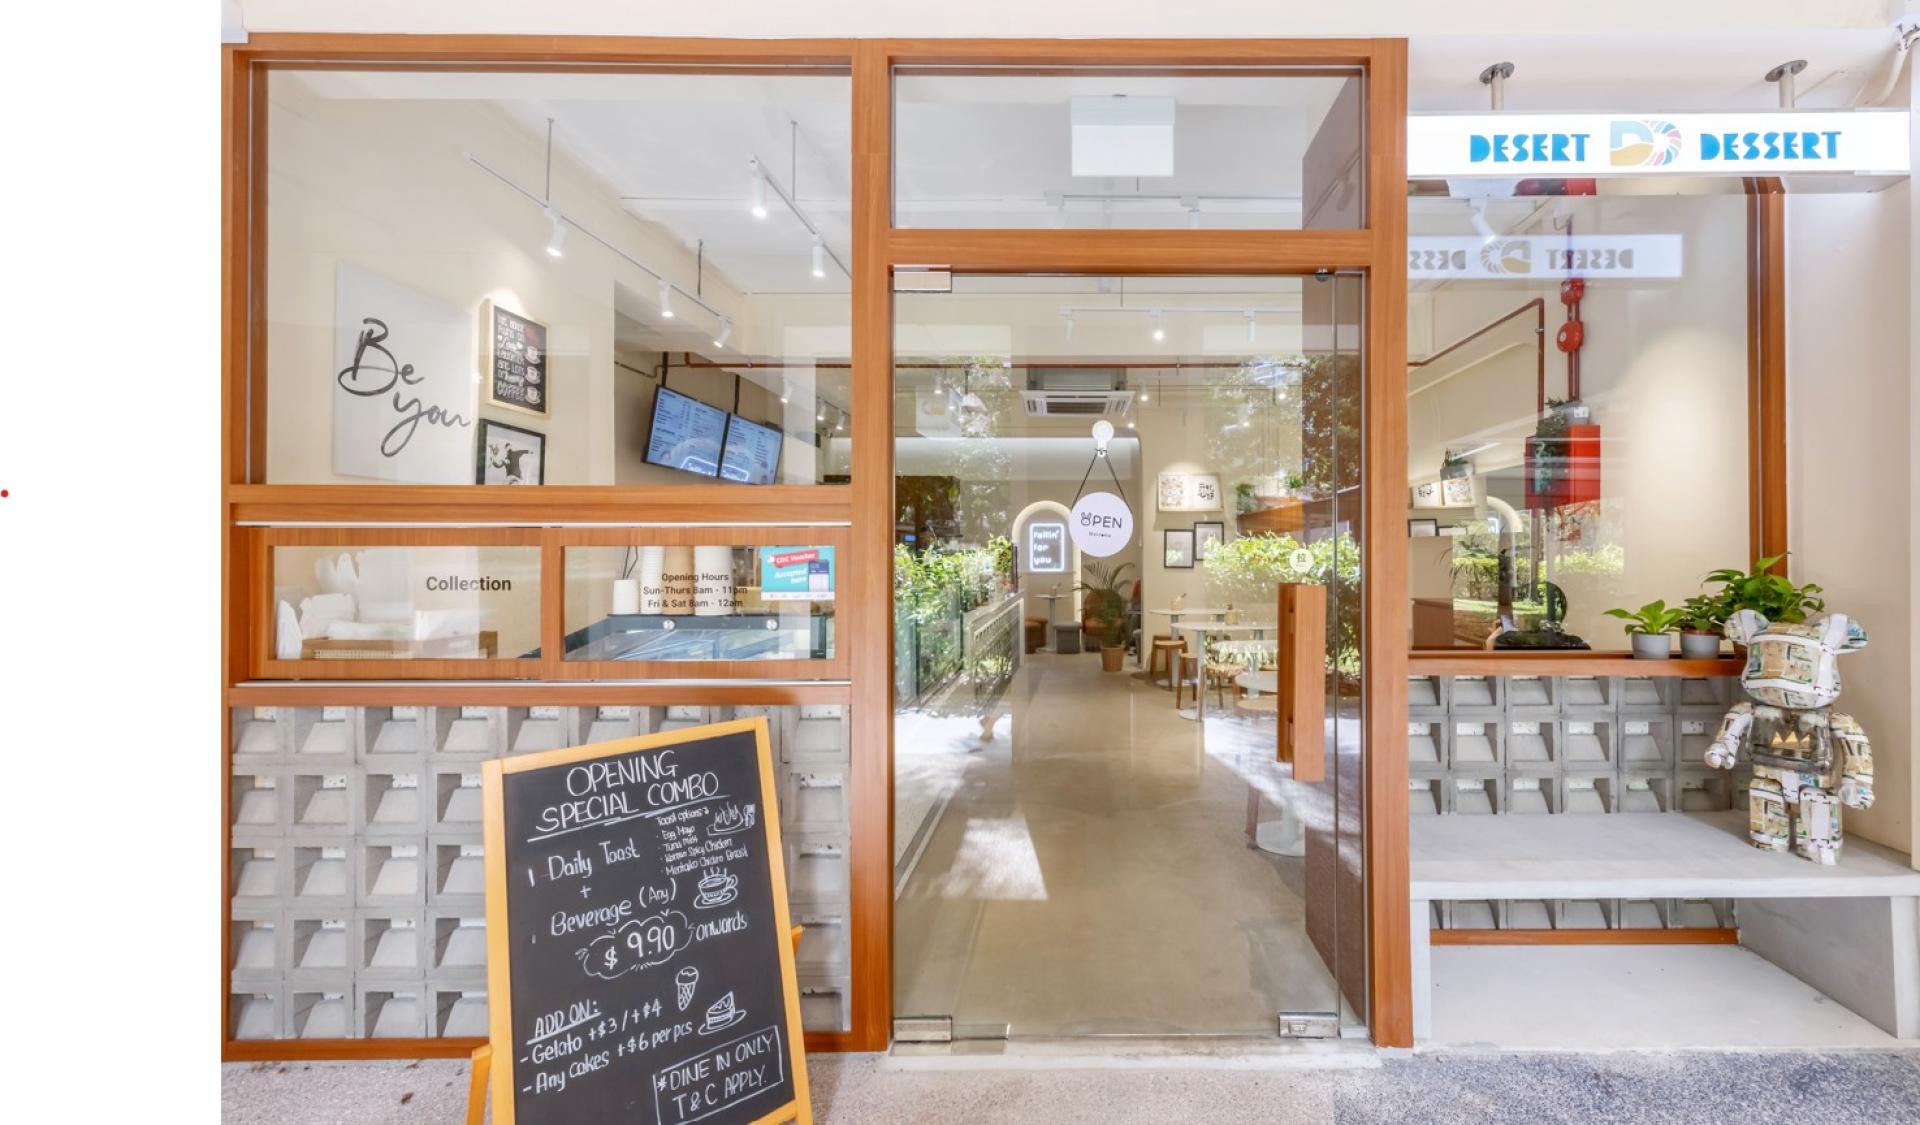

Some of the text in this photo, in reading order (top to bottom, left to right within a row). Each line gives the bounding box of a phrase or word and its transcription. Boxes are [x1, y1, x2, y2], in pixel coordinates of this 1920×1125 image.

[1469, 133, 1591, 163] DESERT
[1700, 131, 1842, 160] DESSERT
[338, 317, 425, 397] Be
[381, 391, 471, 458] you
[1080, 511, 1122, 529] OPEN
[1033, 556, 1052, 565] you
[426, 575, 512, 593] Collection
[643, 586, 691, 595] Sun-Thurs
[692, 586, 713, 594] 8am
[722, 586, 748, 597] 11pm
[661, 573, 729, 583] Opening Hours
[648, 599, 661, 608] Fri
[661, 599, 669, 608] &
[671, 599, 687, 608] Sat
[688, 599, 709, 608] 8am
[718, 599, 744, 608] 12am
[566, 750, 679, 797] OPENING
[535, 772, 719, 832] SPECIAL COMBO
[656, 812, 677, 826] Toast
[661, 825, 696, 841] Egg Mayo
[547, 850, 593, 881] Daily
[598, 838, 641, 865] Toast
[663, 840, 682, 852] Tuna
[551, 877, 677, 936] Beverage (Any)
[626, 925, 675, 957] 9.90
[535, 999, 599, 1041] ADD ON:
[588, 1016, 618, 1041] +$3
[631, 998, 663, 1024] +$4
[569, 1052, 610, 1078] cakes
[617, 1031, 649, 1057] +$6
[652, 1026, 672, 1051] per
[673, 1020, 693, 1046] pcs
[716, 1051, 731, 1072] IN
[736, 1033, 774, 1063] ONLY
